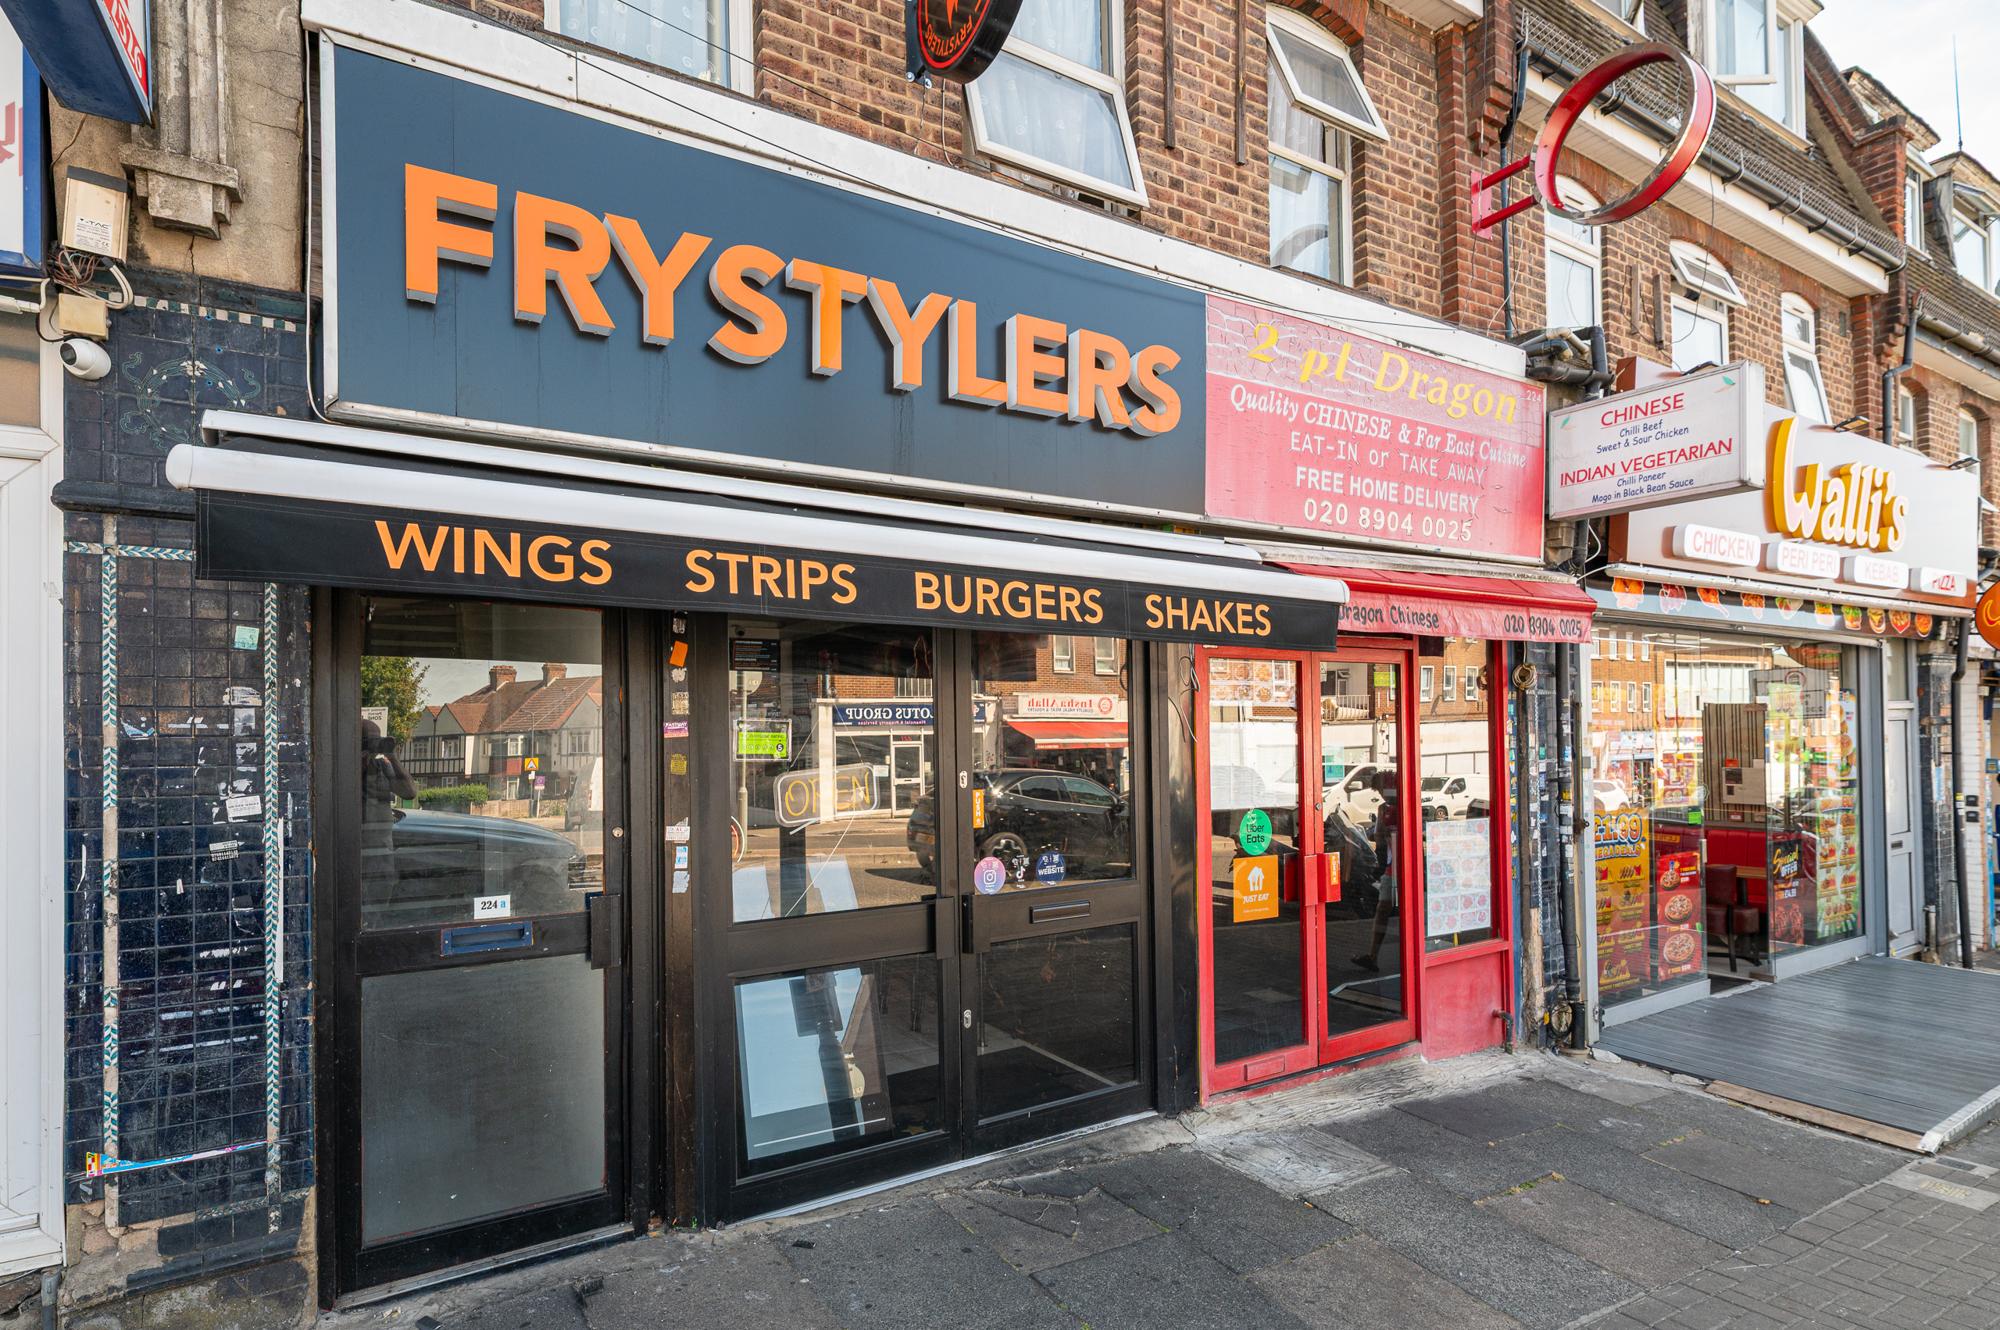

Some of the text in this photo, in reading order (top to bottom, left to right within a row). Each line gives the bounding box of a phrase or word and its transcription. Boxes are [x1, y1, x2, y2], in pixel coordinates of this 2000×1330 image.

[925, 14, 973, 57] FRYSTYLERS
[404, 163, 1181, 437] FRYSTYLERS
[1373, 351, 1516, 426] Dragon
[1601, 392, 1685, 427] CHINESE
[1230, 383, 1527, 469] Quality CHINESE & Far East Cuisine
[1596, 426, 1689, 454] Sweet & Sour Chicken
[1619, 419, 1664, 438] Chilli Beef
[1290, 431, 1488, 487] EAT-IN or TAKE AWAY
[1560, 437, 1733, 487] INDIAN VEGETARIAN
[1296, 465, 1481, 517] FREE HOME DELIVERY
[1591, 478, 1694, 504] Mogo in Black Bean Sauce
[1616, 471, 1667, 487] Chilli Paneer
[1773, 417, 1910, 552] Walli's
[1304, 498, 1473, 541] 020 8904 0025
[1693, 530, 1755, 561] CHICKEN
[1782, 546, 1837, 574] PERI PERI
[374, 520, 1272, 637] WINGS STRIPS BURGERS SHAKES
[1390, 604, 1440, 629] Chinese
[1503, 614, 1583, 638] 020 8904 0025
[1246, 823, 1265, 833] Uber
[1246, 834, 1266, 844] Eats
[1595, 846, 1614, 860] EGA
[1037, 865, 1065, 876] WEBSITE
[480, 900, 498, 911] 224
[1243, 892, 1270, 904] JUST EAT
